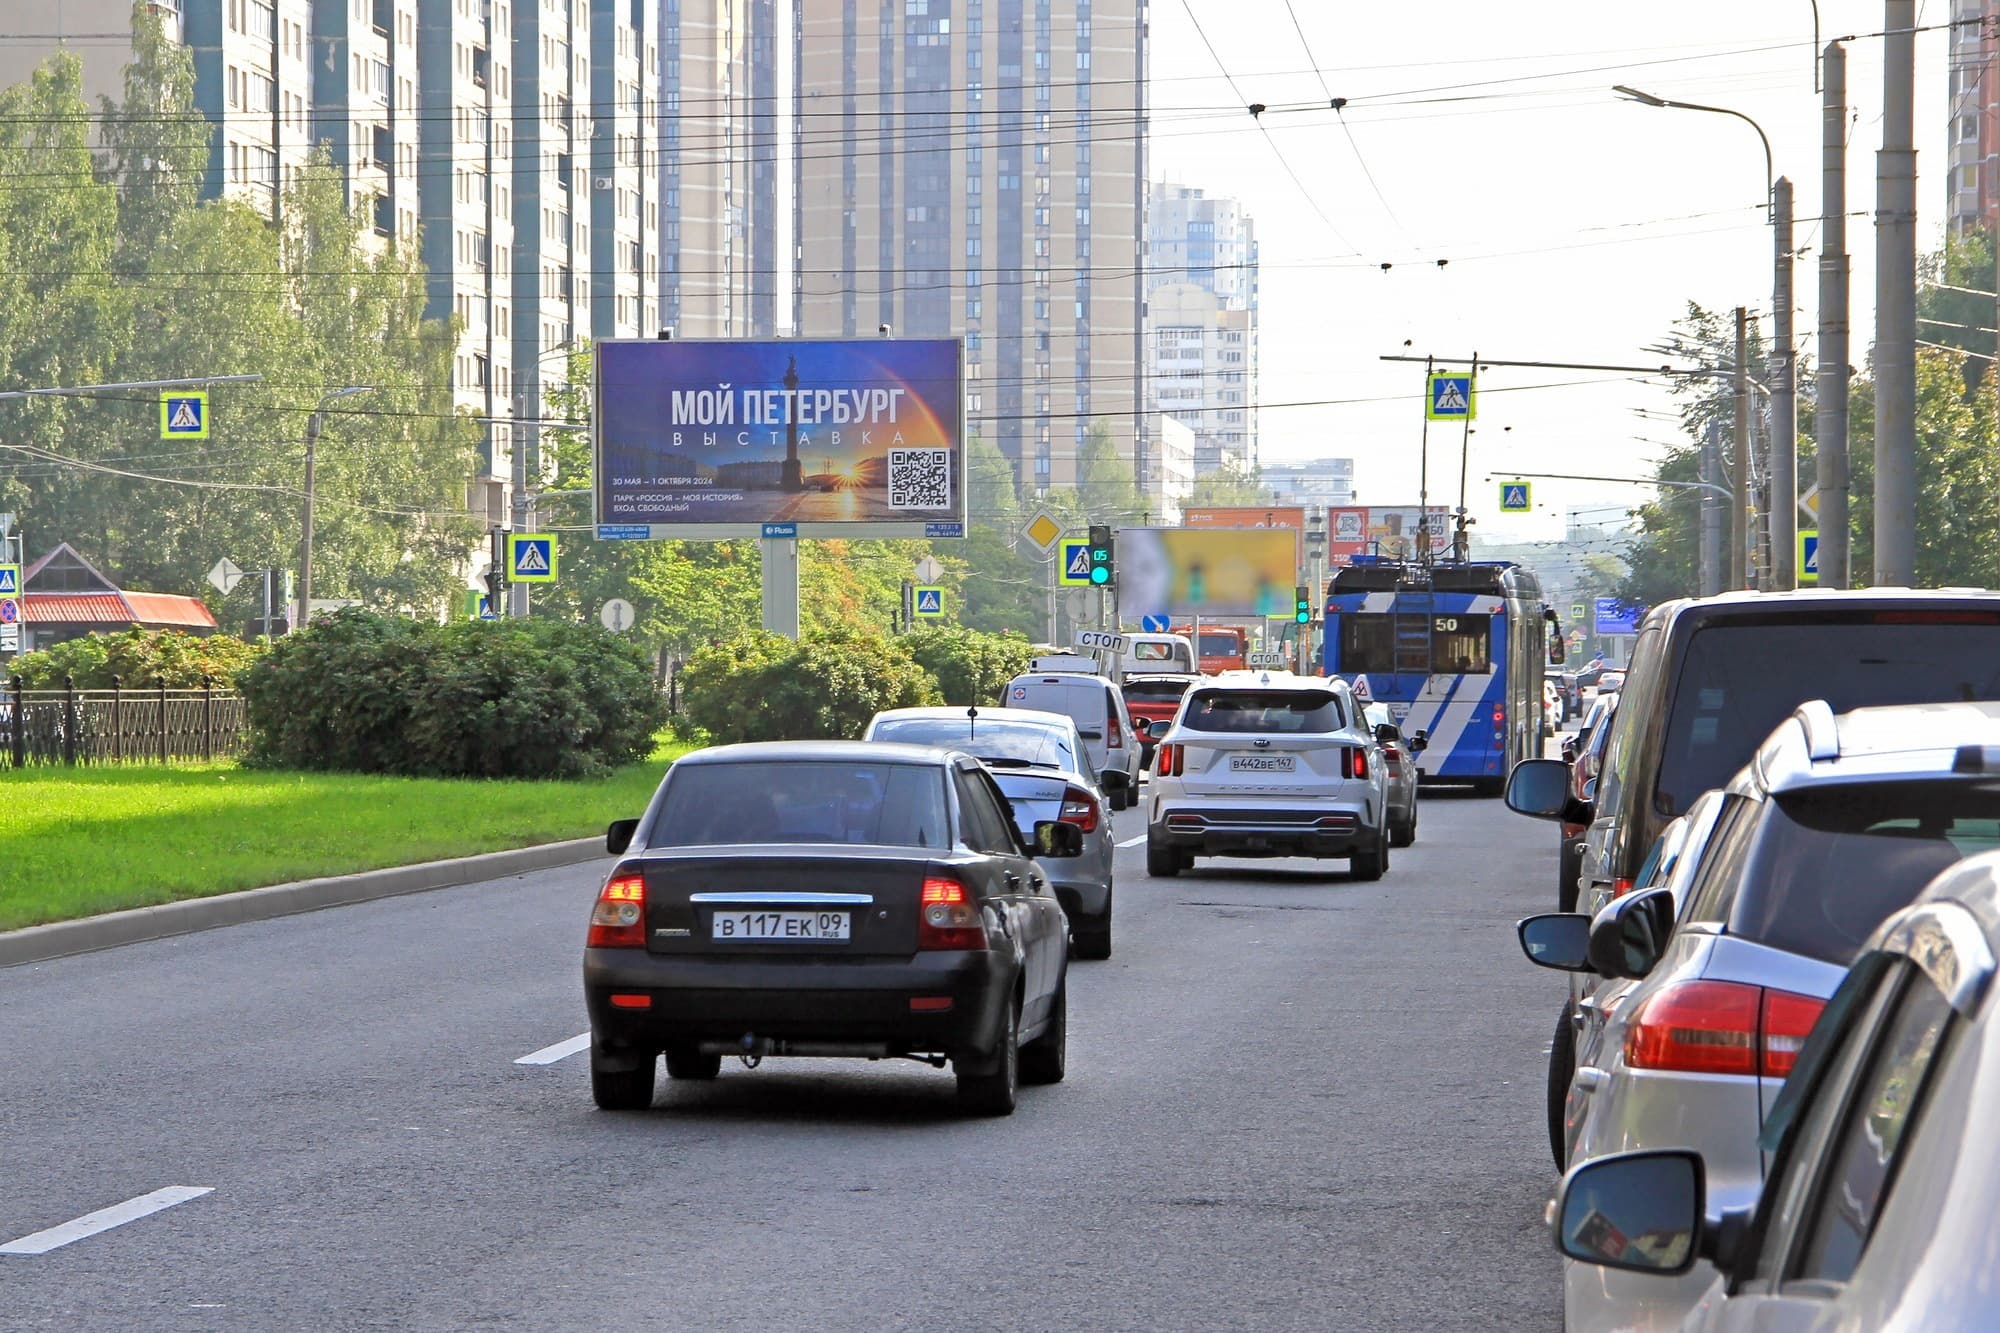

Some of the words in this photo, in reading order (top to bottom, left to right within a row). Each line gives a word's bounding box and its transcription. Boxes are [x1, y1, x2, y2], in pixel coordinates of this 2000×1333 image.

[672, 383, 734, 425] МОЙ
[743, 389, 905, 425] ПЕТЕРБУРГ
[673, 431, 905, 446] ВЫСТАВКА
[613, 478, 623, 486] 30
[657, 477, 691, 485] ОКТЯБРЯ
[693, 477, 713, 485] 2024
[613, 494, 635, 502] ПАРК
[636, 494, 673, 502] «РОССИЯ
[702, 493, 744, 501] ИСТОРИЯ»
[613, 504, 635, 512] ВХОД
[637, 502, 690, 512] СВОБОДНЫЙ
[1409, 525, 1444, 535] КБО
[1093, 550, 1108, 561] 05
[1435, 618, 1457, 631] 50
[1081, 632, 1122, 650] СТОП
[1251, 654, 1280, 664] СТОП
[819, 913, 842, 930] 09
[822, 930, 840, 938] RUS
